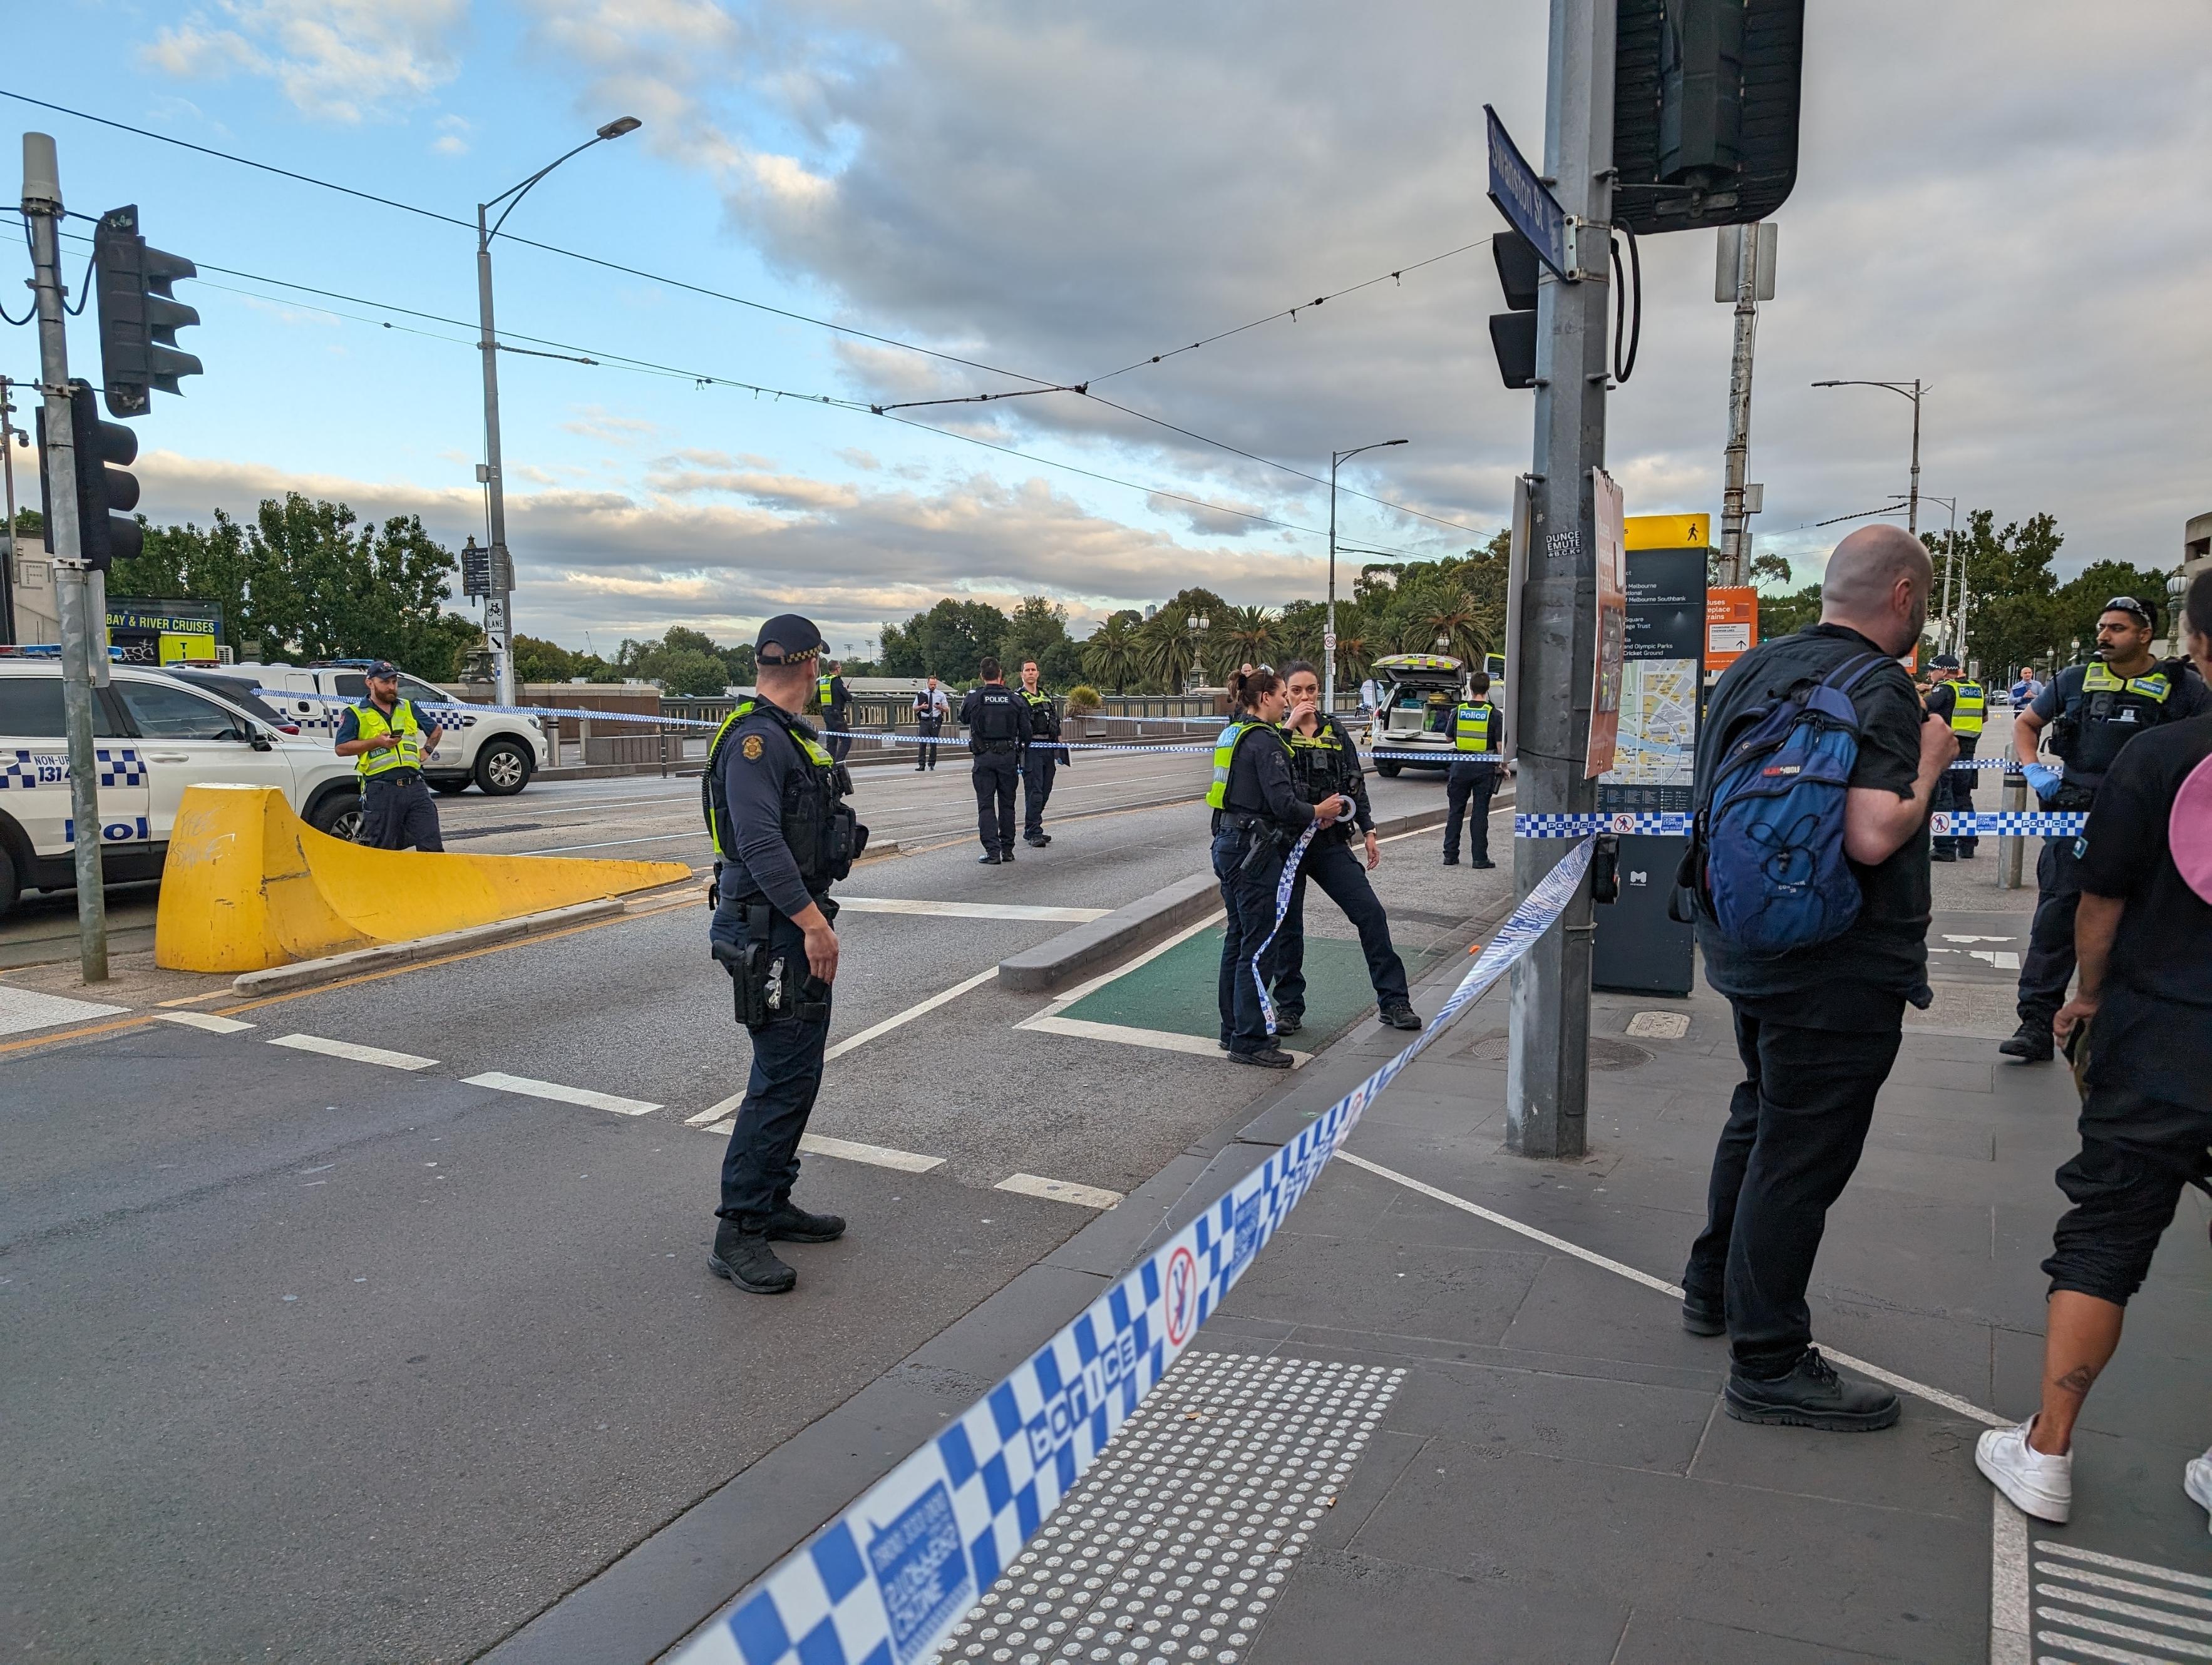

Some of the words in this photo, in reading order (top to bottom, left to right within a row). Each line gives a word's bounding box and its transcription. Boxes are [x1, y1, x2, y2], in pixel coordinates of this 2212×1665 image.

[1491, 119, 1532, 217] Swanston
[1535, 184, 1543, 232] St
[1546, 531, 1580, 543] DUNCE
[1547, 539, 1581, 551] EMUTE
[106, 614, 126, 626] BAY
[129, 616, 136, 627] &
[139, 617, 170, 630] RIVER
[172, 620, 215, 633] CRUISES
[488, 620, 503, 628] LANE
[1959, 687, 1982, 697] Police
[2136, 680, 2162, 693] Police
[1460, 710, 1486, 719] Police
[371, 747, 387, 758] HEALTH
[34, 756, 69, 766] NON-UR
